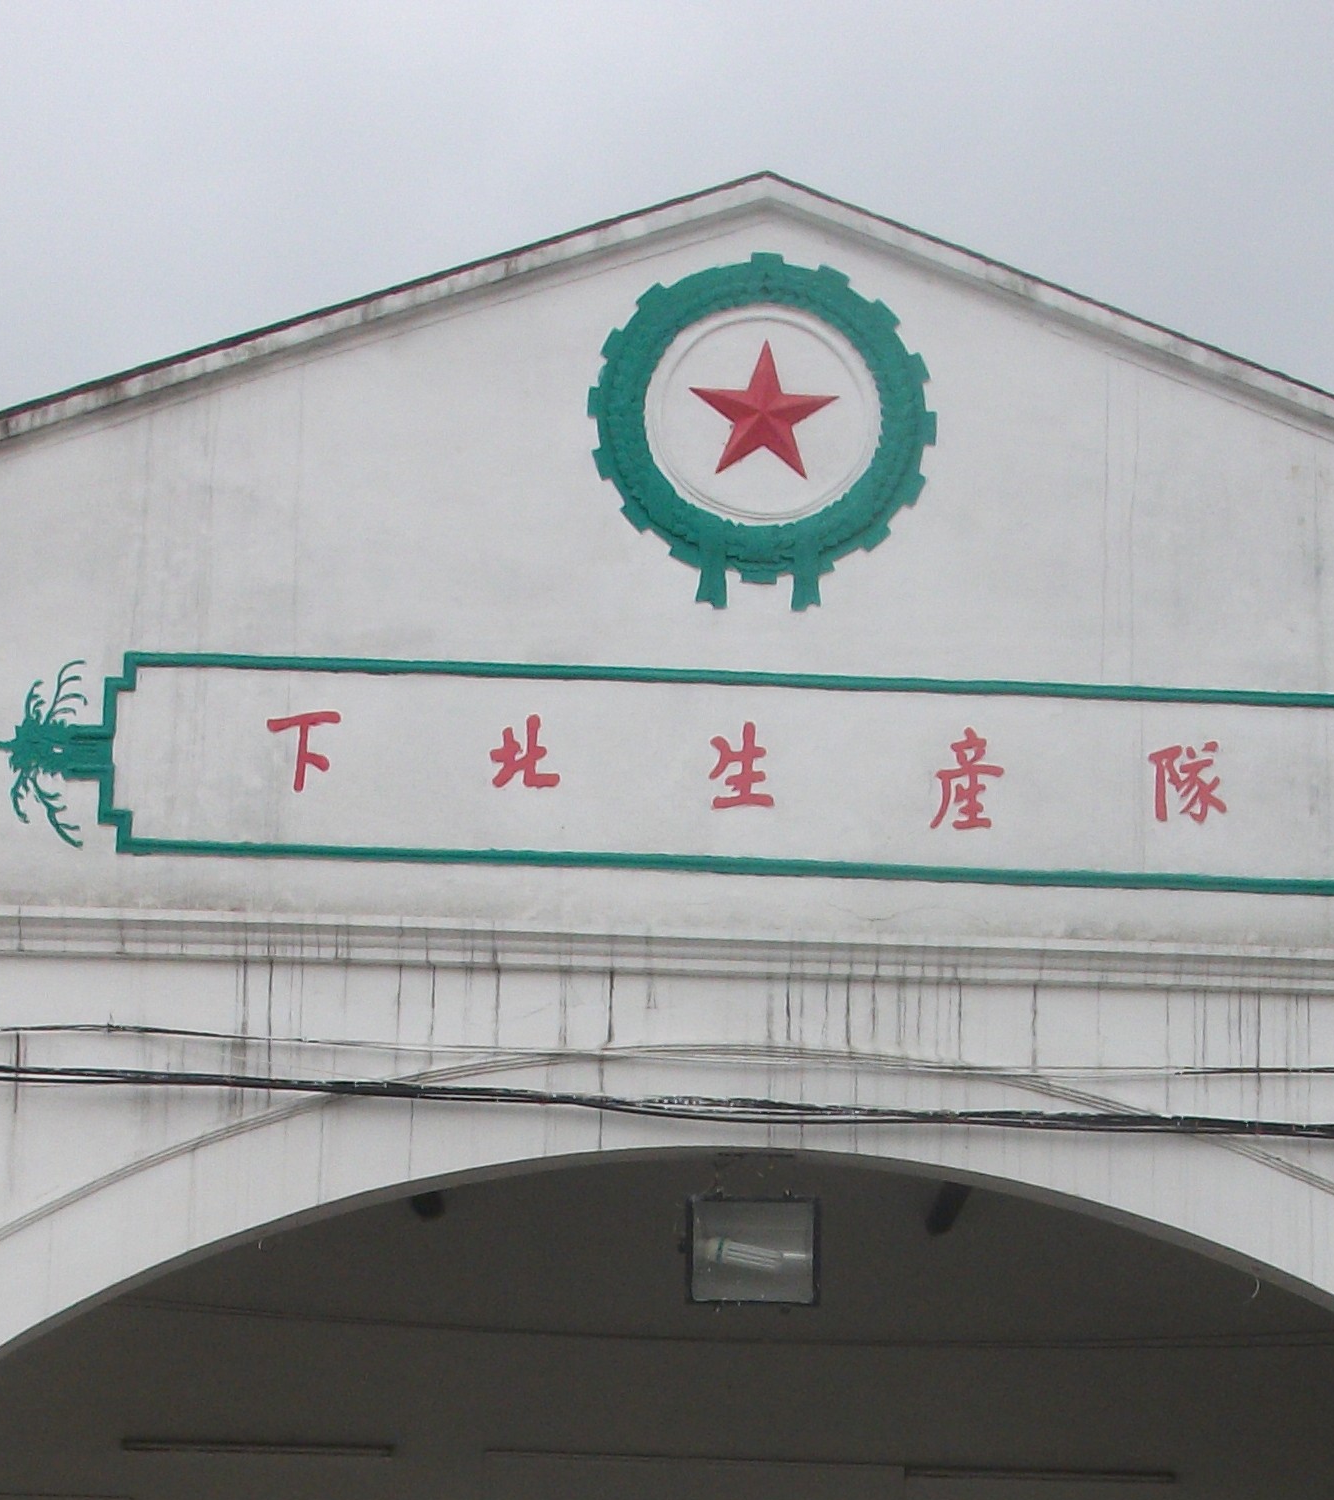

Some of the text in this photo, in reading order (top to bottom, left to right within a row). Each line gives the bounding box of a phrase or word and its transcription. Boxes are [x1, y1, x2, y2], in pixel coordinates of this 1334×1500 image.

[267, 710, 1228, 831] 下北生産隊
